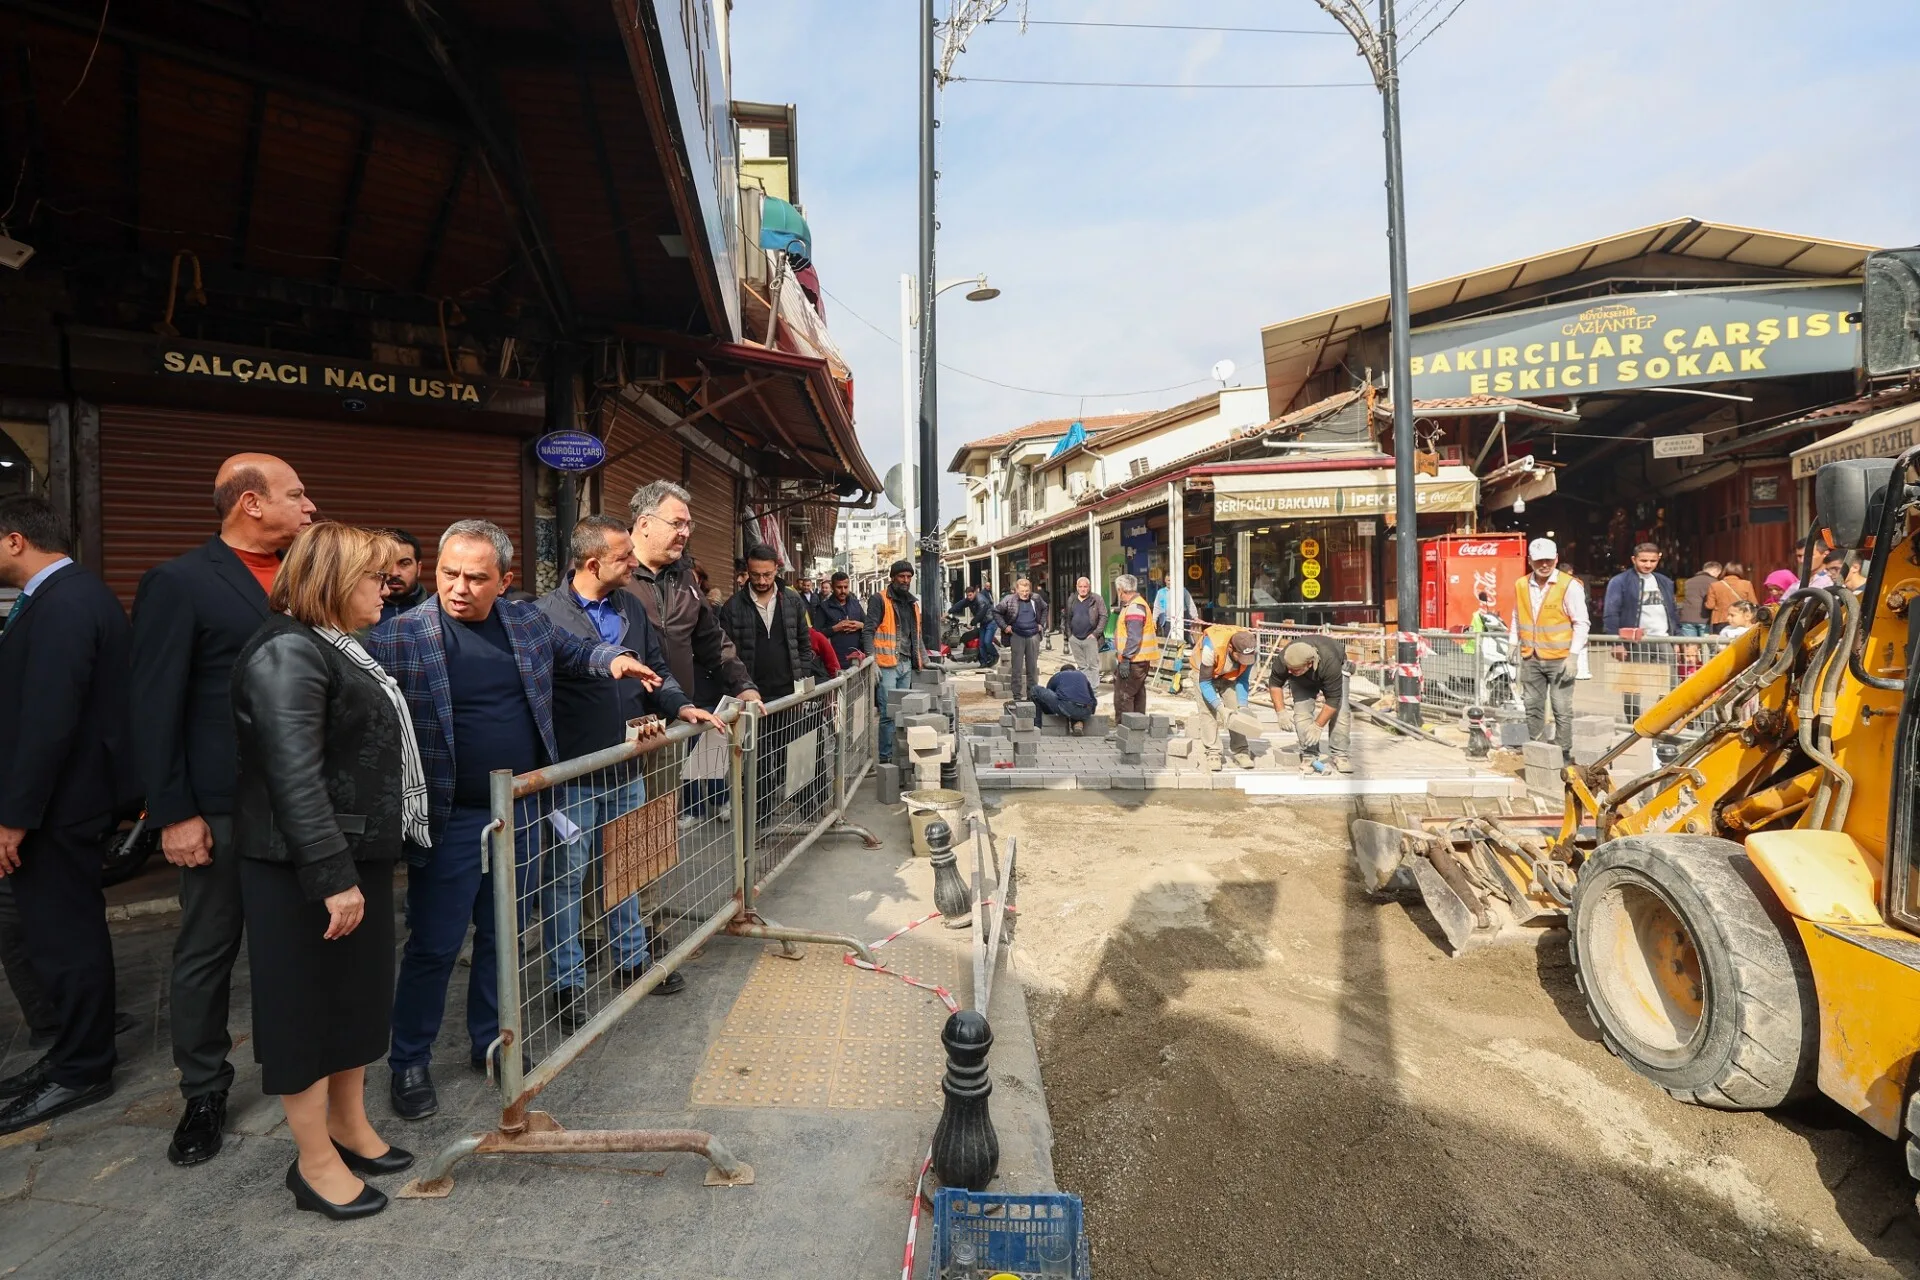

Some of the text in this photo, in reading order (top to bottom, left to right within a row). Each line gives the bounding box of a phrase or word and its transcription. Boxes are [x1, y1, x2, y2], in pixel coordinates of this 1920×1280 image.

[1562, 314, 1657, 336] GAZİANTEP
[1410, 310, 1850, 376] BAKIRCILAR ÇARŞISI
[163, 351, 480, 403] SALÇACI NACI USTA
[1470, 347, 1766, 395] ESKİCİ SOKAK
[582, 447, 602, 458] ÇARŞI
[1214, 495, 1330, 515] ŞERİFOĞLU BAKLAVA
[1351, 492, 1385, 507] İPEK
[1459, 543, 1500, 556] Coca-Cola
